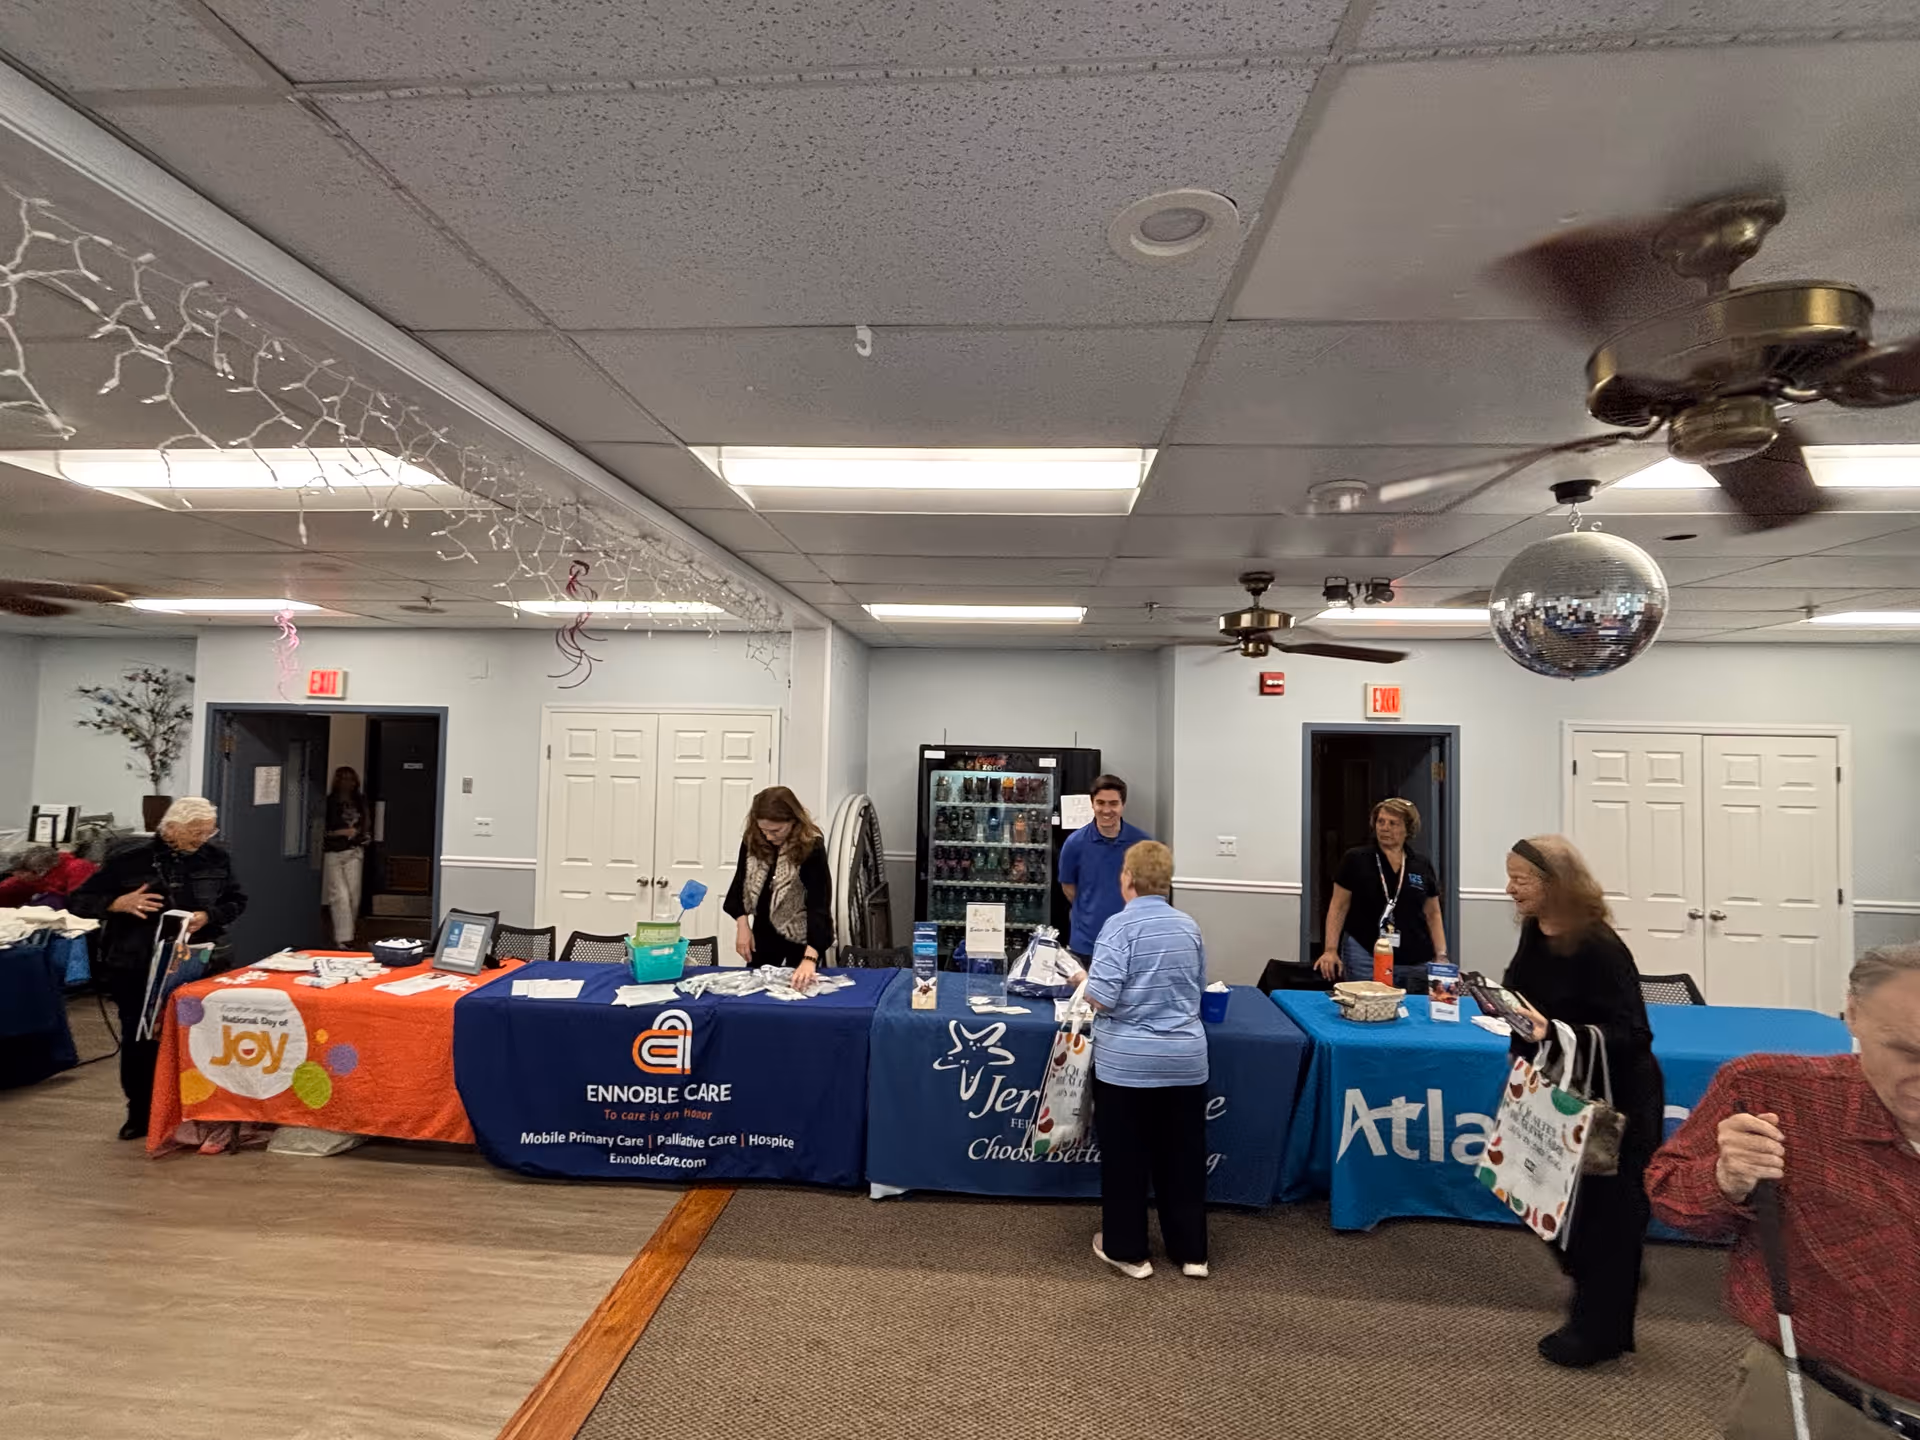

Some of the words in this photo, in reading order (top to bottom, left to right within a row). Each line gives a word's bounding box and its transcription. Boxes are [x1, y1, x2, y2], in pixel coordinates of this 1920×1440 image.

[309, 671, 339, 695] EXIT
[1372, 687, 1400, 713] EXIT
[221, 1014, 259, 1025] National
[260, 1016, 277, 1028] Day
[278, 1018, 289, 1027] of
[587, 1085, 680, 1104] ENNOBLE
[684, 1083, 733, 1103] CARE
[604, 1108, 617, 1121] To
[621, 1111, 646, 1121] care
[650, 1111, 660, 1121] is
[664, 1110, 679, 1120] an
[520, 1131, 566, 1145] Mobile
[569, 1131, 614, 1148] Primary
[617, 1135, 644, 1147] Care
[657, 1133, 705, 1148] Palliative
[708, 1134, 737, 1147] Care
[749, 1134, 795, 1149] Hospice
[609, 1152, 707, 1168] EnnobleCare.com
